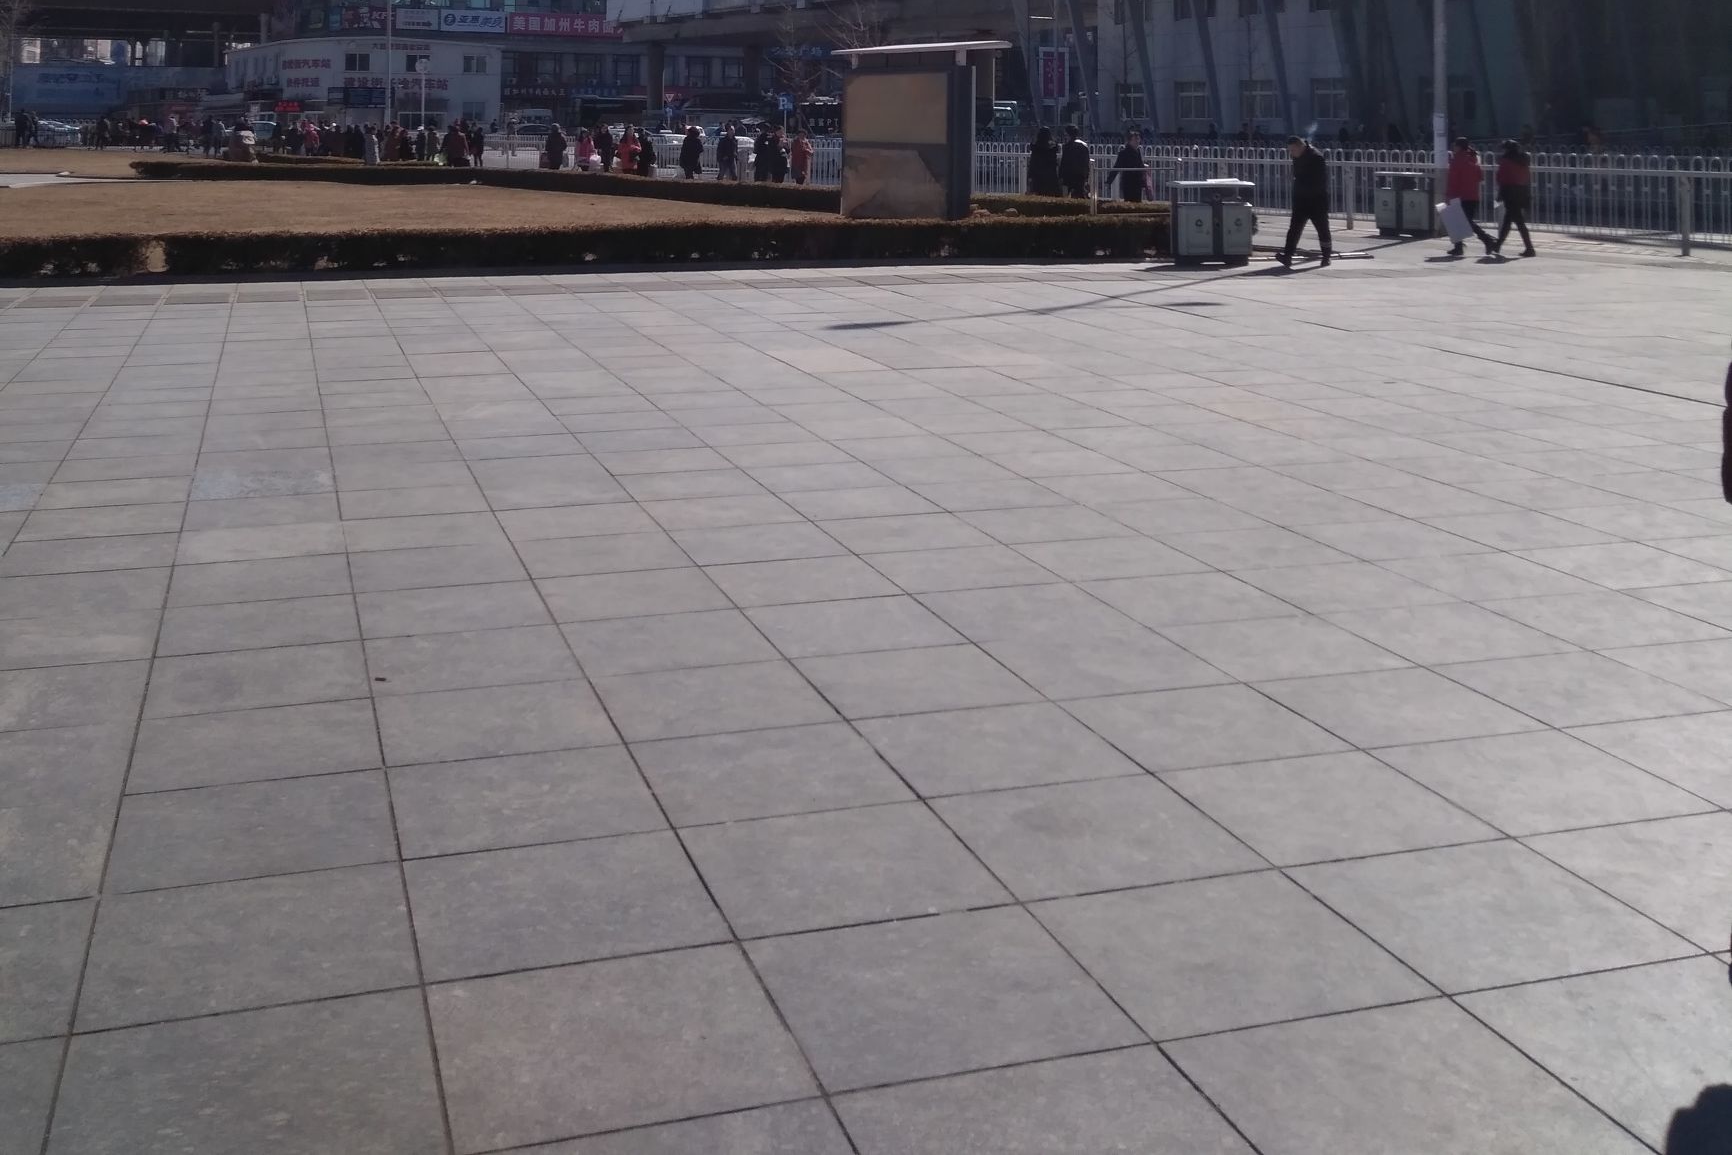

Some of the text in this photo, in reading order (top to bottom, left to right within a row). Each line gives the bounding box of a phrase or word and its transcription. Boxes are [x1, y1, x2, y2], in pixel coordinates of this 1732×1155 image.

[371, 11, 396, 20] KFC
[512, 16, 623, 34] 美国加州牛肉面
